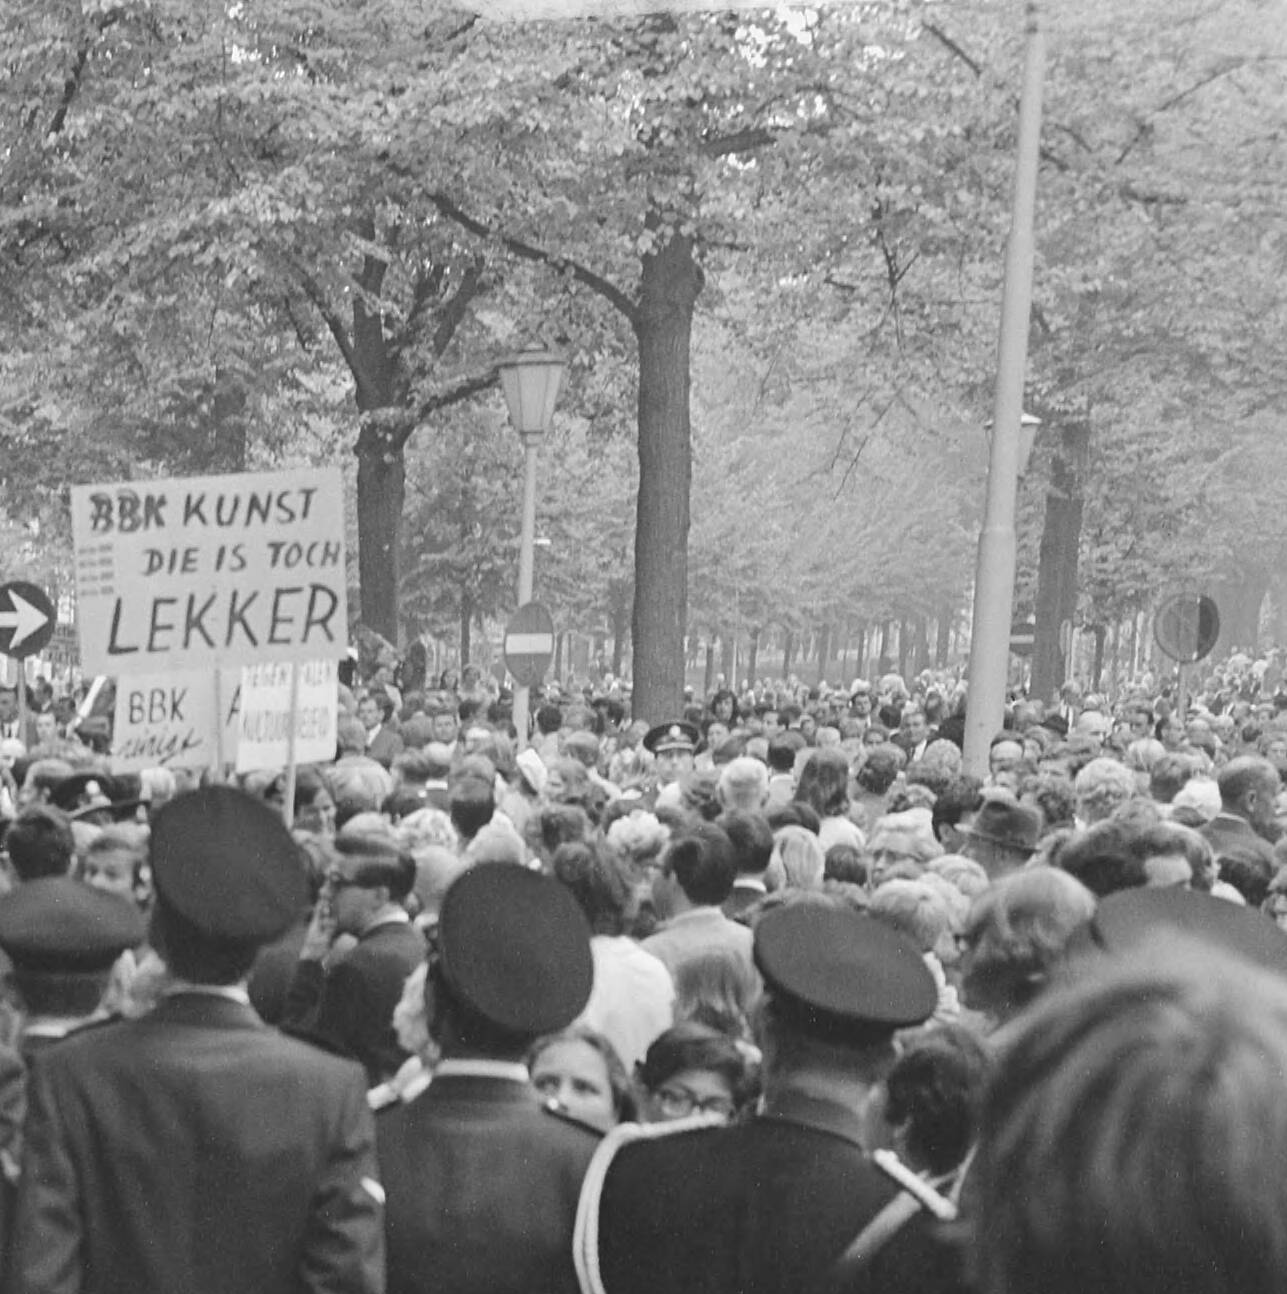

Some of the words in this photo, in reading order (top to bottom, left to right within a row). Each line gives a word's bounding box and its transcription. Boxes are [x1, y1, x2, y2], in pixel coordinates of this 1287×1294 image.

[89, 489, 167, 533] BBK
[182, 487, 318, 528] KUNST
[143, 546, 200, 576] DIE
[215, 544, 248, 573] IS
[267, 539, 342, 569] TOCH
[107, 583, 339, 655] LEKKER
[129, 686, 189, 725] BBK
